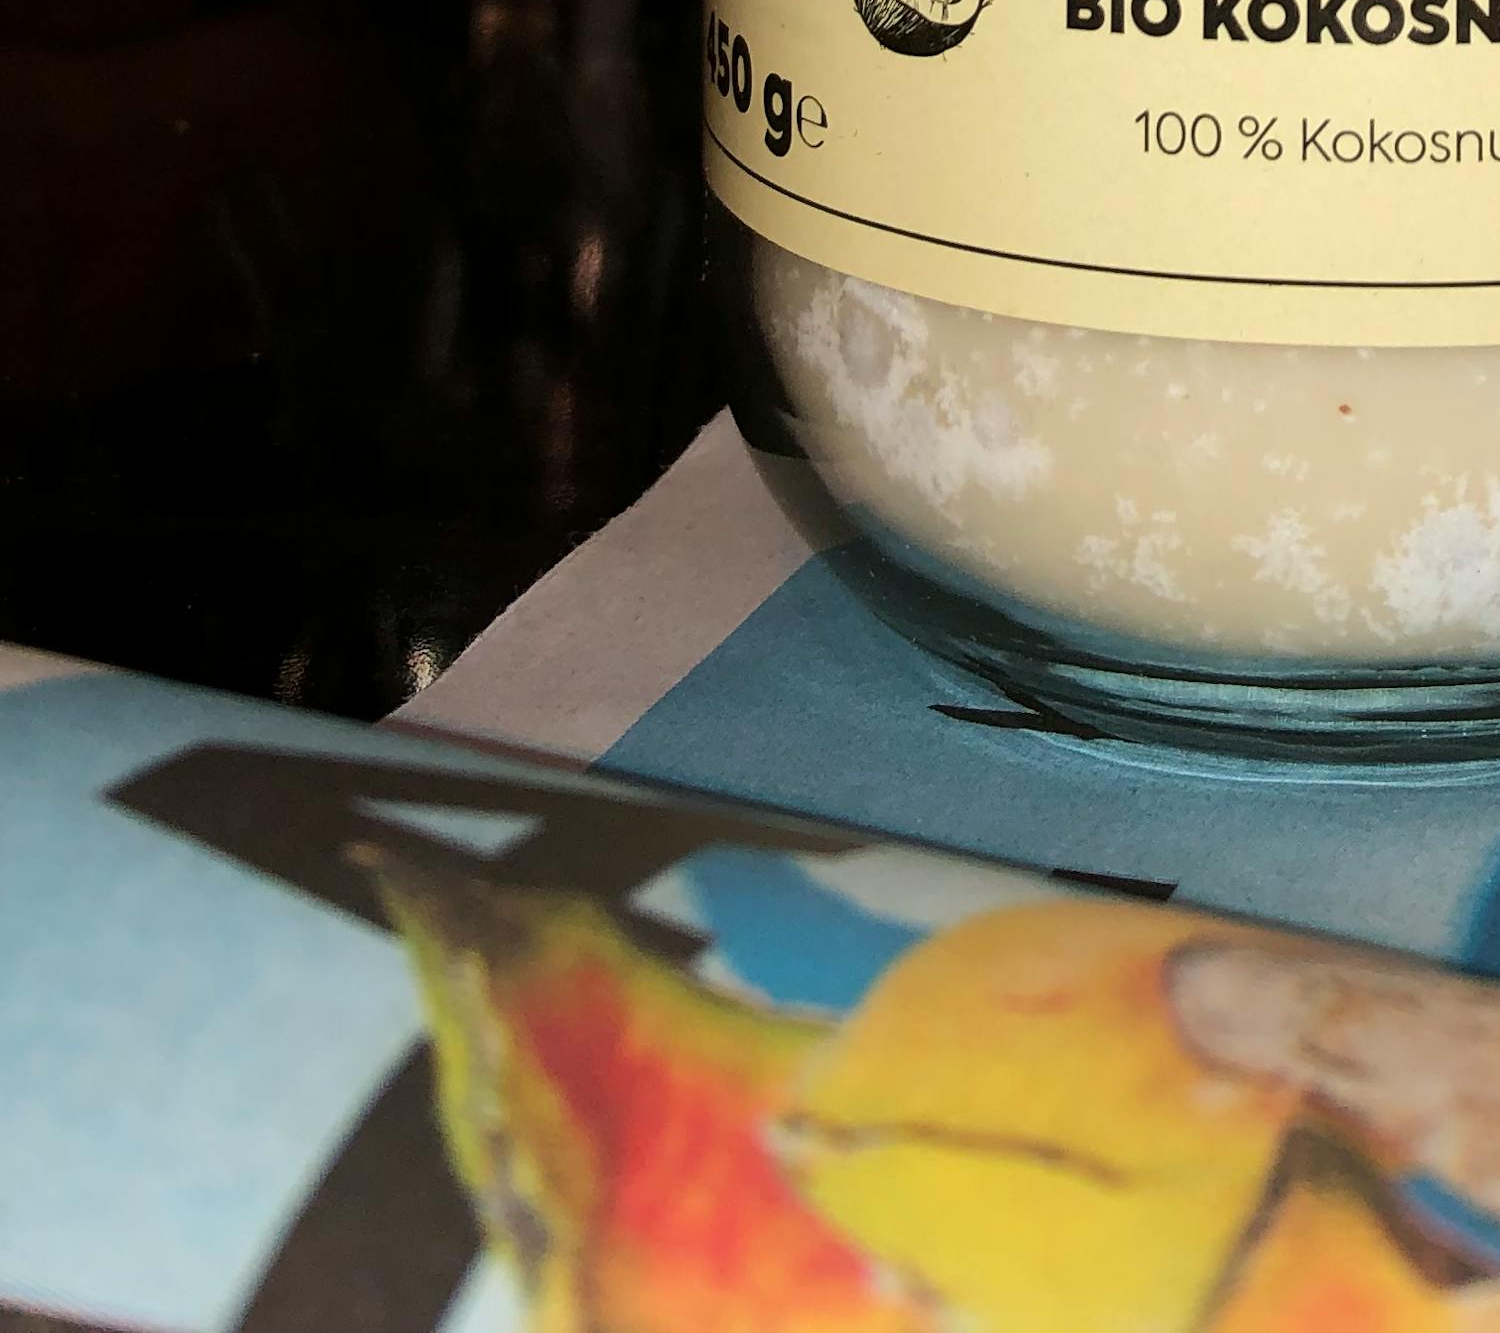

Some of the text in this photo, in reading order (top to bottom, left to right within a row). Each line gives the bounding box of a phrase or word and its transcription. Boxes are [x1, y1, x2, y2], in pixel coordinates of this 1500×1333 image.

[763, 73, 792, 157] g
[1135, 110, 1222, 159] 100
[1238, 114, 1284, 162] %
